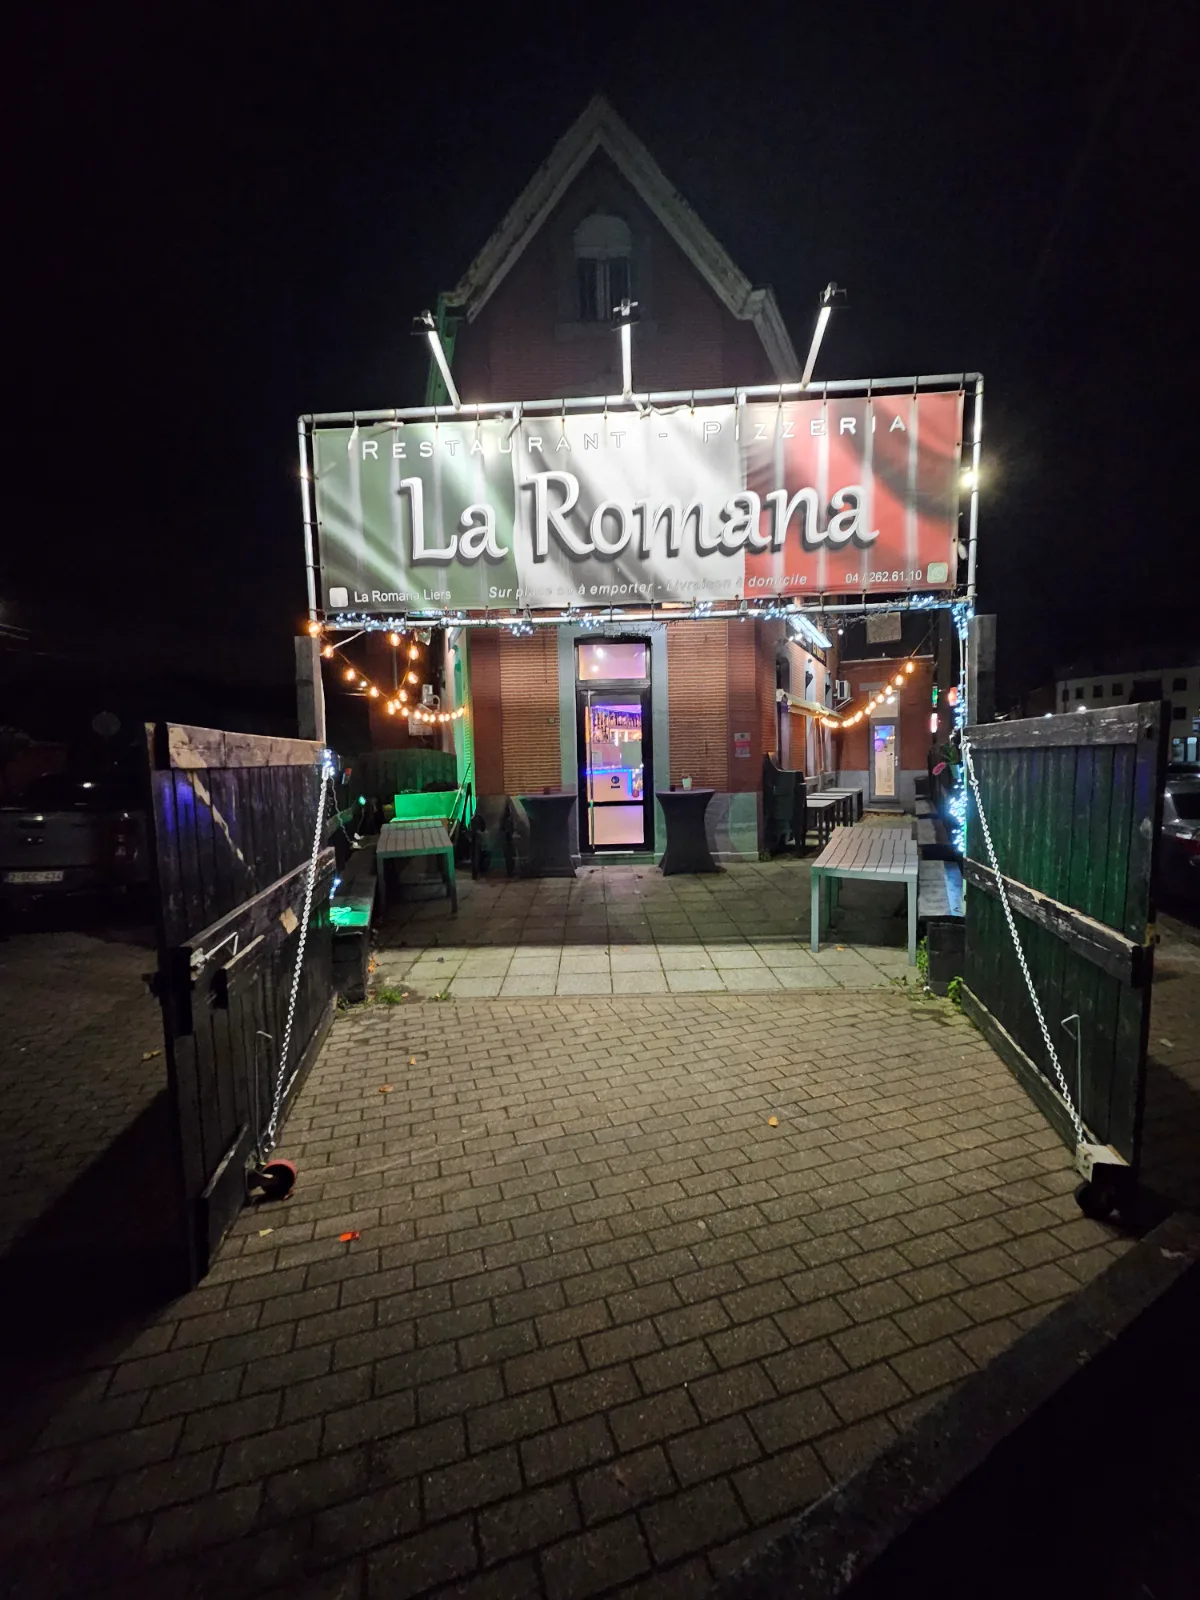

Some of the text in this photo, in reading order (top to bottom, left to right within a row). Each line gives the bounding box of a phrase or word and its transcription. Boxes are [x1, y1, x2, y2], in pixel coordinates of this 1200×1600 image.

[362, 431, 627, 461] RESTAURANT
[703, 415, 908, 443] PIZZERIA
[399, 470, 880, 563] La Romana
[845, 573, 859, 584] 04
[869, 569, 923, 583] 262.61.10
[354, 589, 452, 603] La Romana Liers
[488, 586, 512, 598] Sur
[590, 582, 654, 597] emporter
